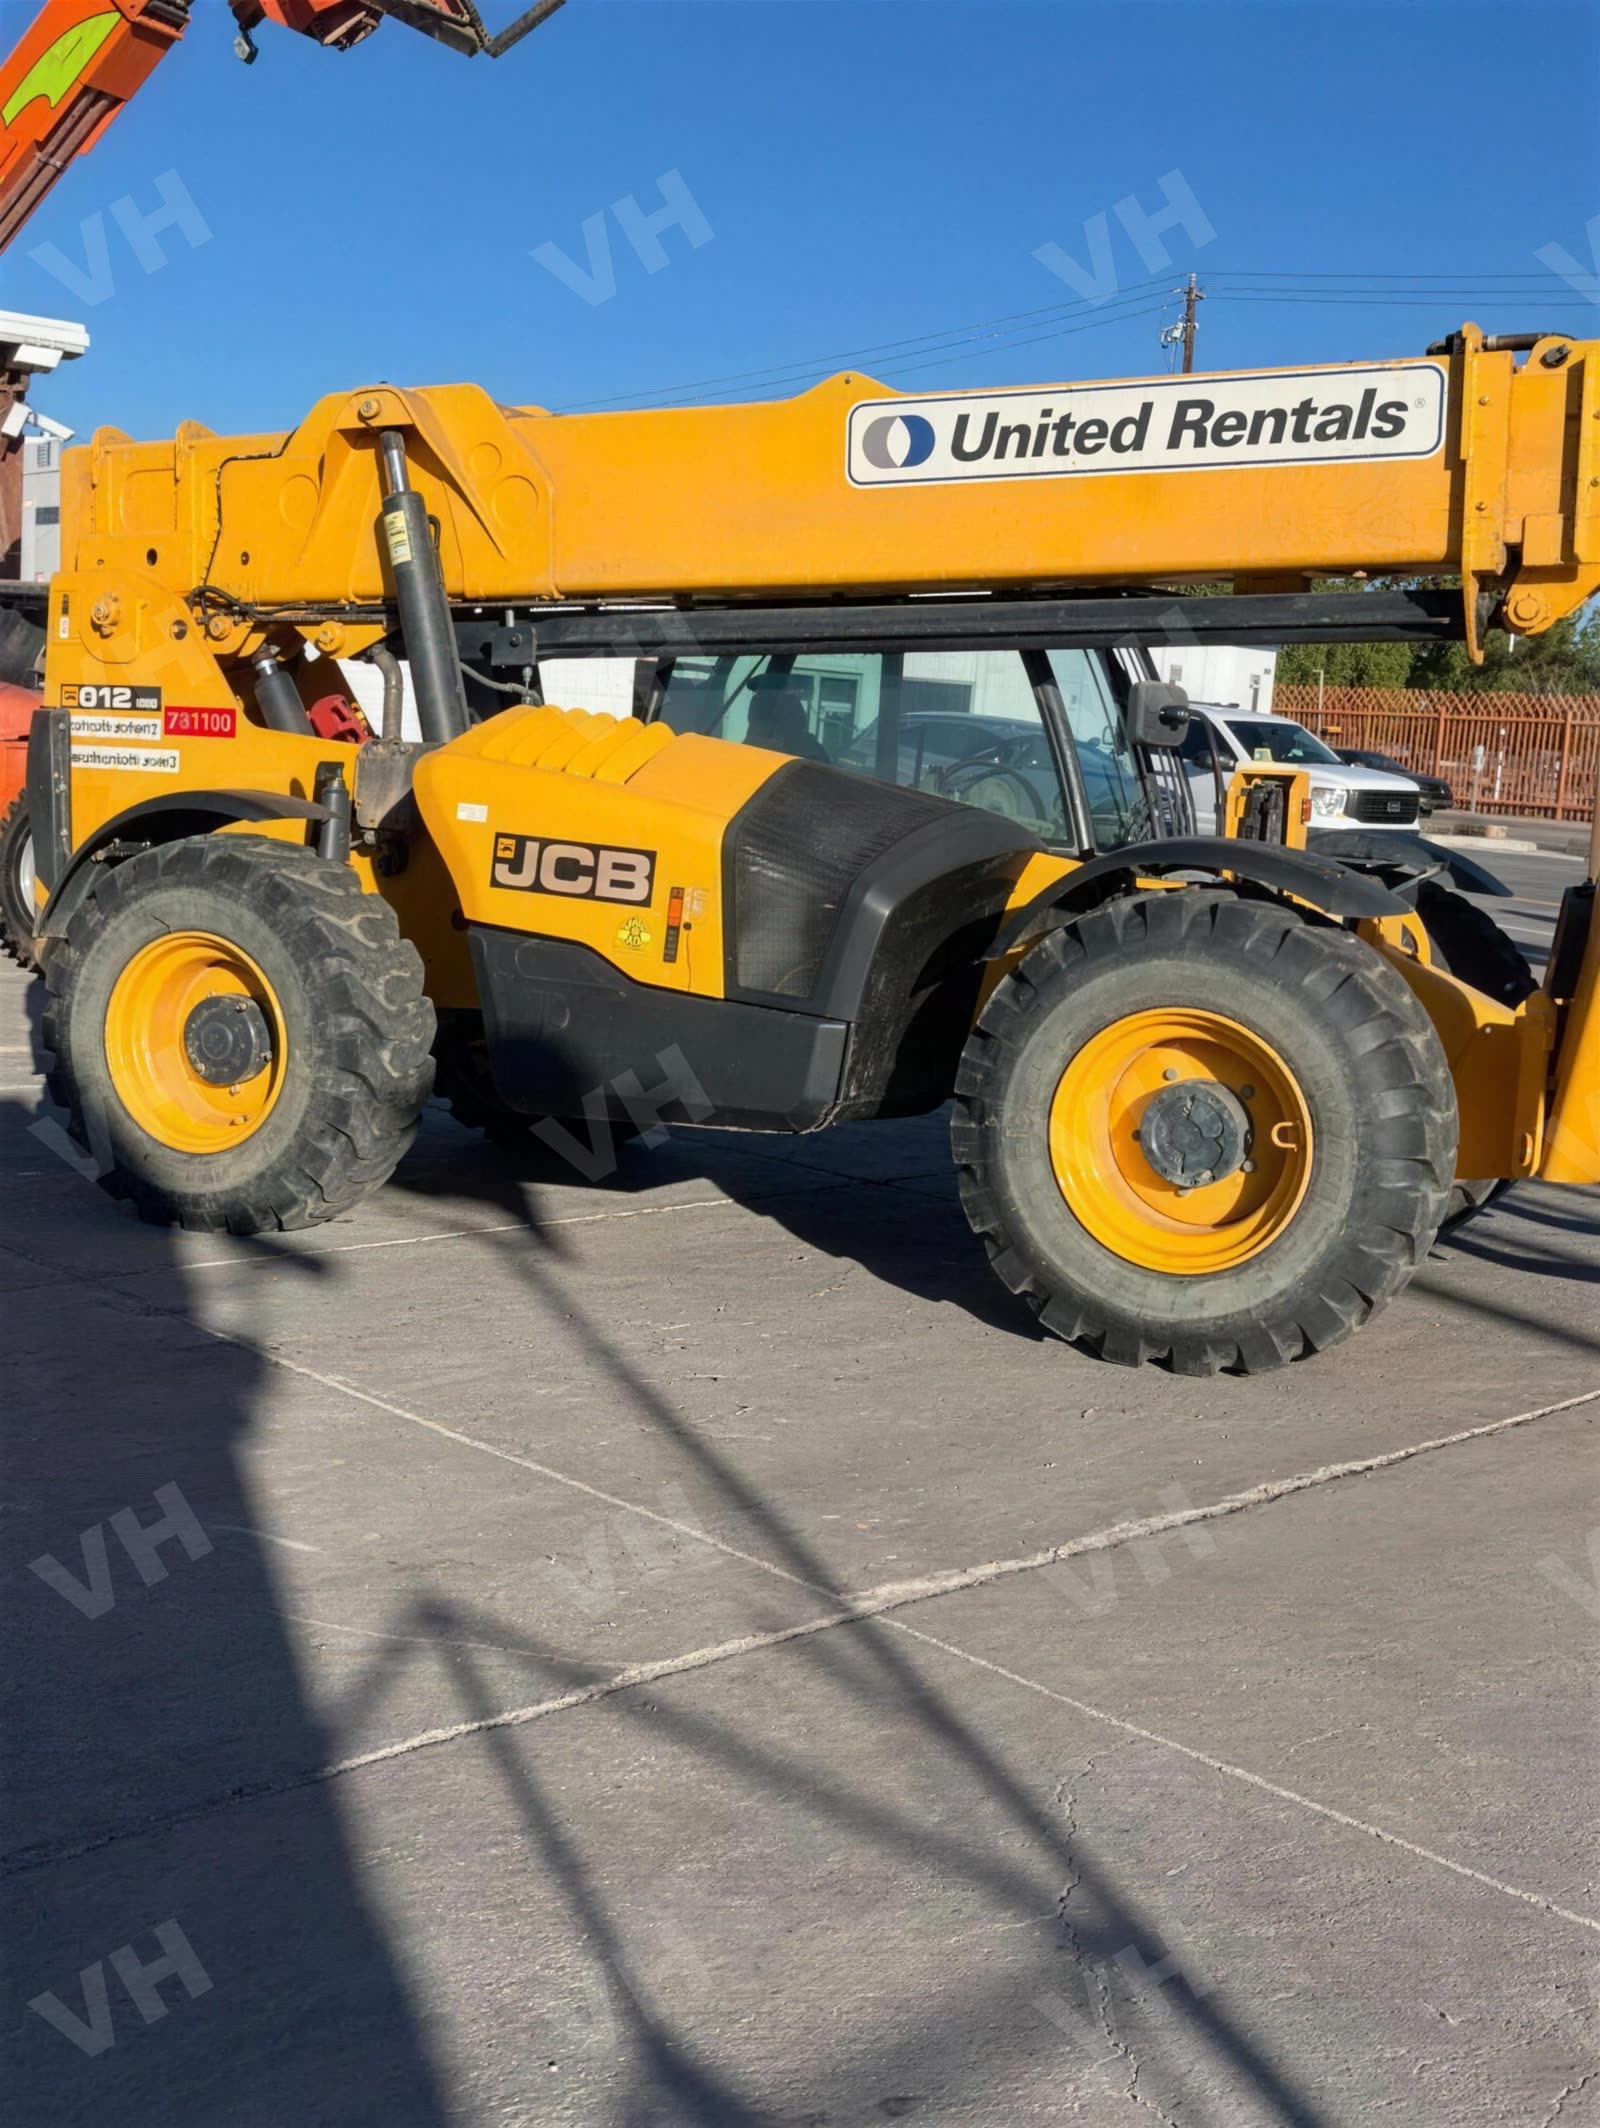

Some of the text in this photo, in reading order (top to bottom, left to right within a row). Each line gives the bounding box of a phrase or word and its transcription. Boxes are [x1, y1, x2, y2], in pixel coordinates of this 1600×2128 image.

[950, 388, 1408, 462] United Rentals
[494, 840, 651, 902] JCB
